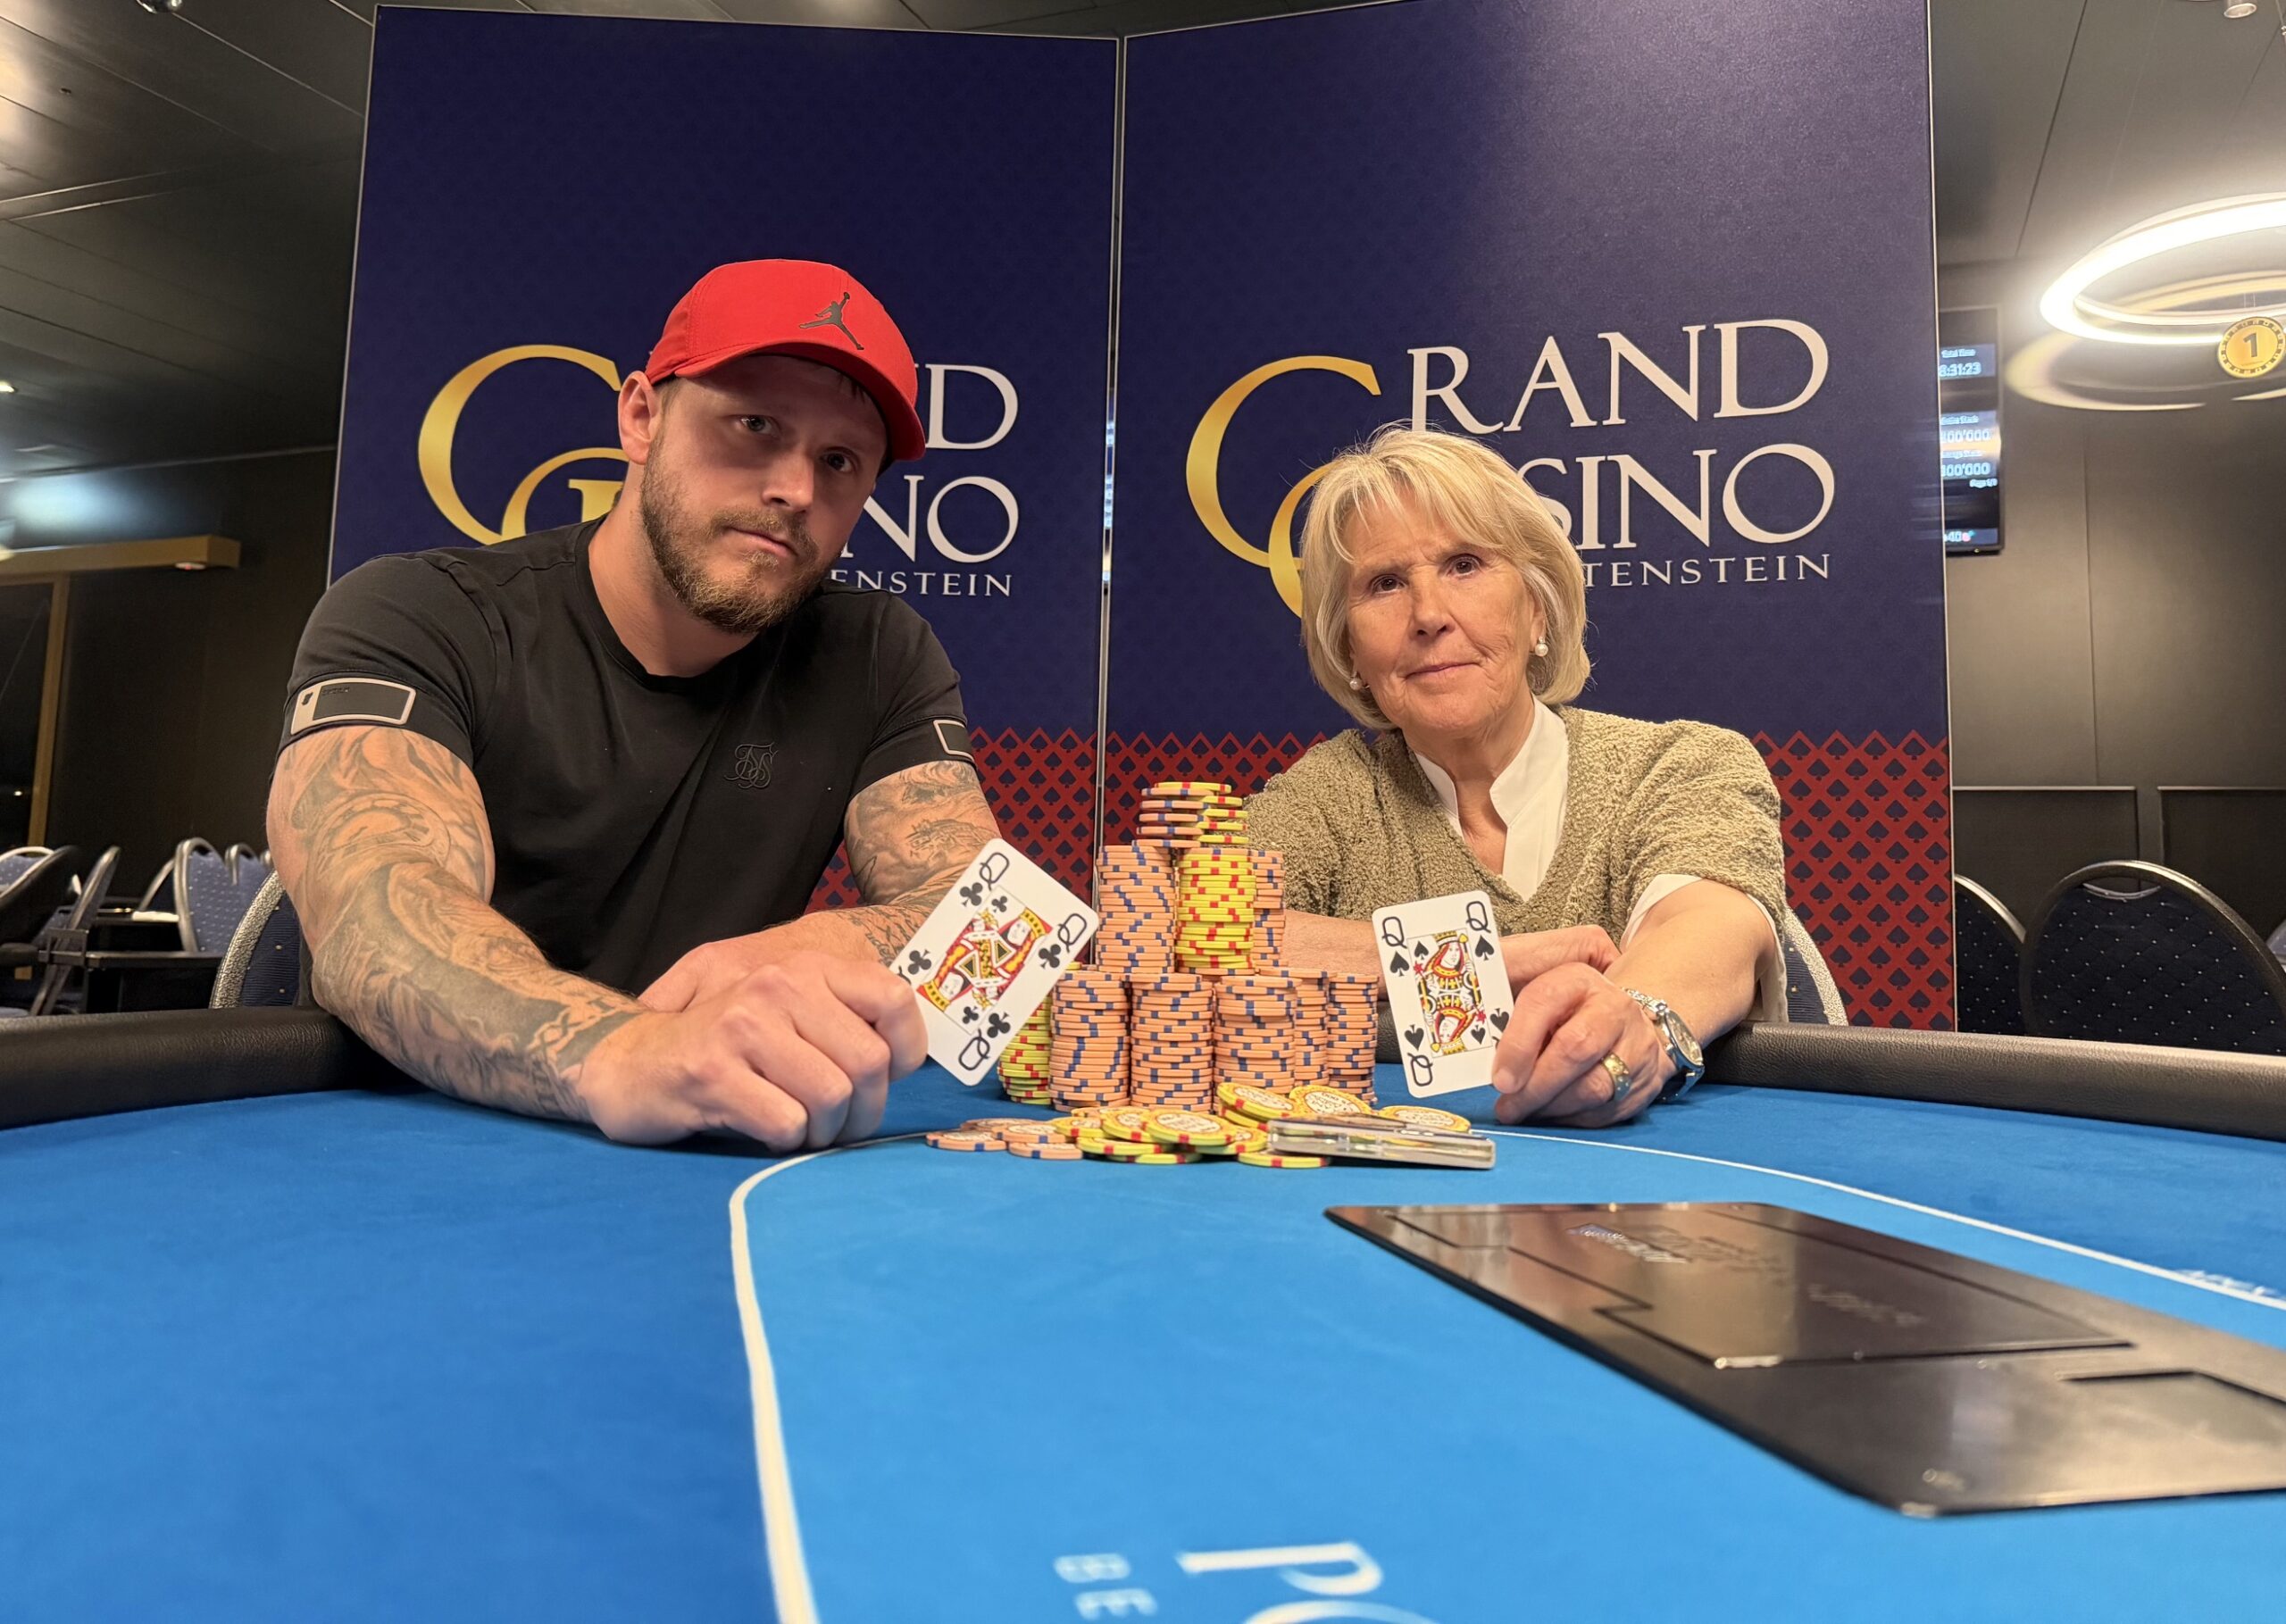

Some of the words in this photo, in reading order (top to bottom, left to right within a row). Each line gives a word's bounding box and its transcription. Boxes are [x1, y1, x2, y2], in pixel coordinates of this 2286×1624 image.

[2242, 331, 2258, 358] 1
[1406, 319, 1829, 434] RAND
[1515, 443, 1835, 550] SINO
[841, 475, 1019, 563] NO
[830, 569, 1012, 597] ENSTEIN
[1582, 554, 1830, 588] TENSTEIN
[979, 851, 1010, 891] Q
[1057, 912, 1088, 954] Q
[1381, 915, 1408, 950] Q
[1465, 900, 1491, 934] Q
[958, 1028, 991, 1071] Q
[1407, 1052, 1433, 1087] Q
